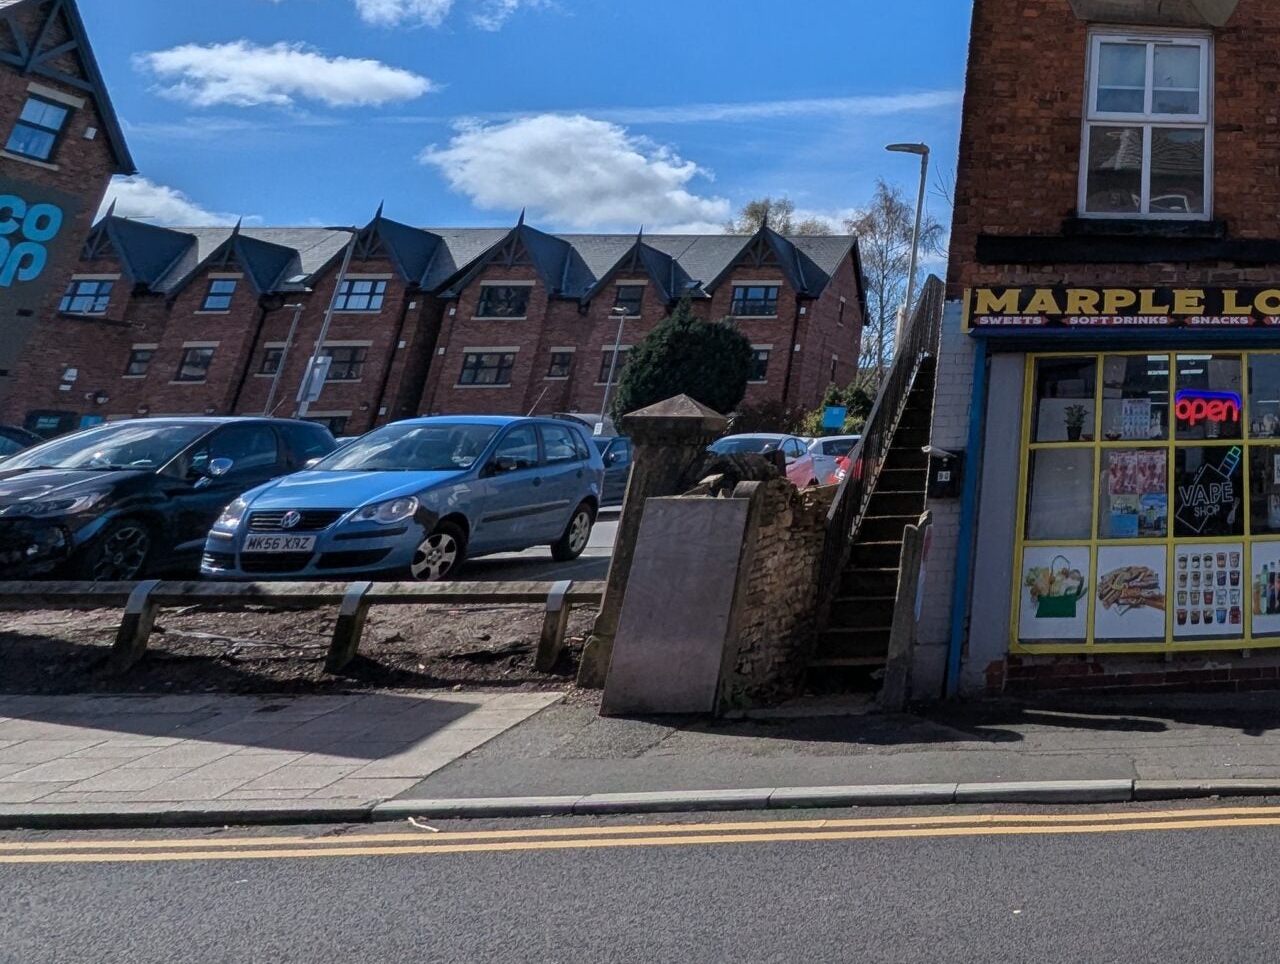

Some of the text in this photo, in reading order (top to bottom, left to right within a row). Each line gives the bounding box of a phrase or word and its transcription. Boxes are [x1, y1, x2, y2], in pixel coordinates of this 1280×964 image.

[974, 288, 1205, 315] MARPLE
[979, 316, 1042, 325] SWEETS
[1069, 316, 1168, 325] SOFT DRINKS
[1191, 316, 1249, 325] SNACKS
[1175, 397, 1239, 426] open
[1178, 481, 1234, 507] VAPE
[1193, 504, 1221, 517] SHOP
